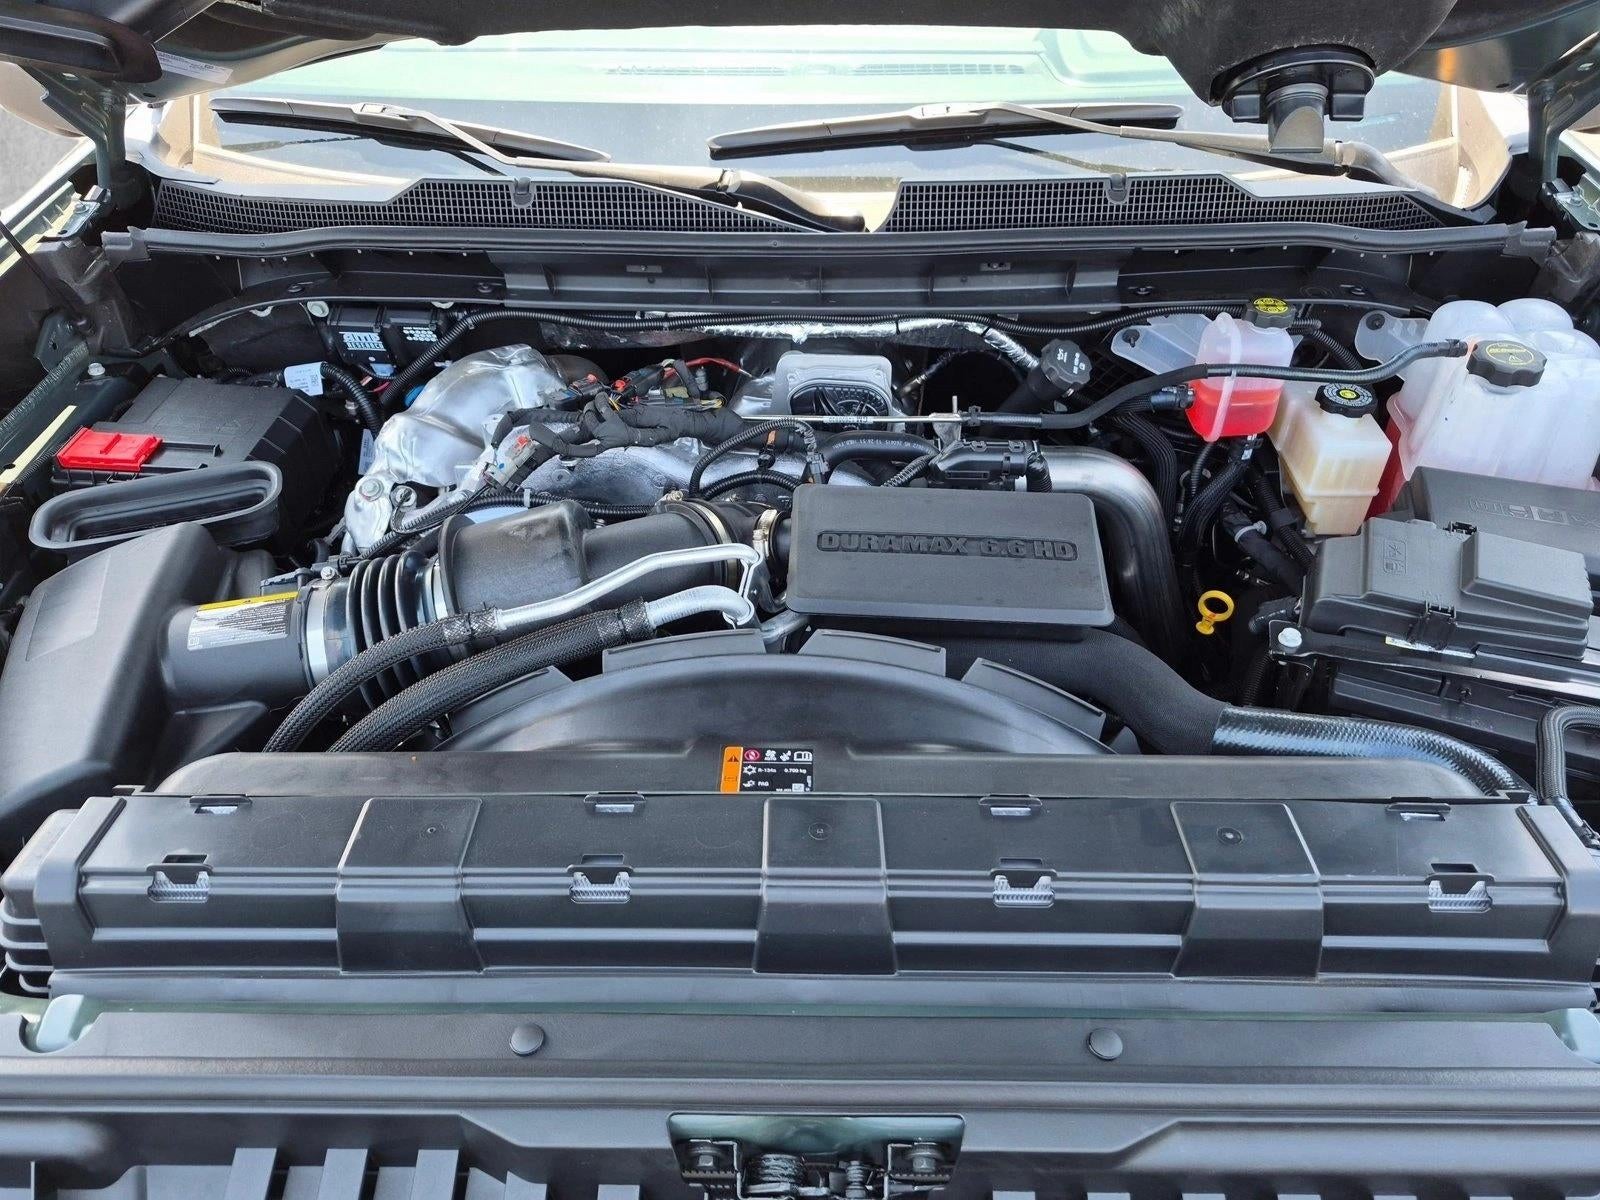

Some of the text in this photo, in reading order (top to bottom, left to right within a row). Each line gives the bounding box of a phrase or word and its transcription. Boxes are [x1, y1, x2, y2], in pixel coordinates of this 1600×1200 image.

[820, 533, 1075, 560] DURAMAX 6.6 HD
